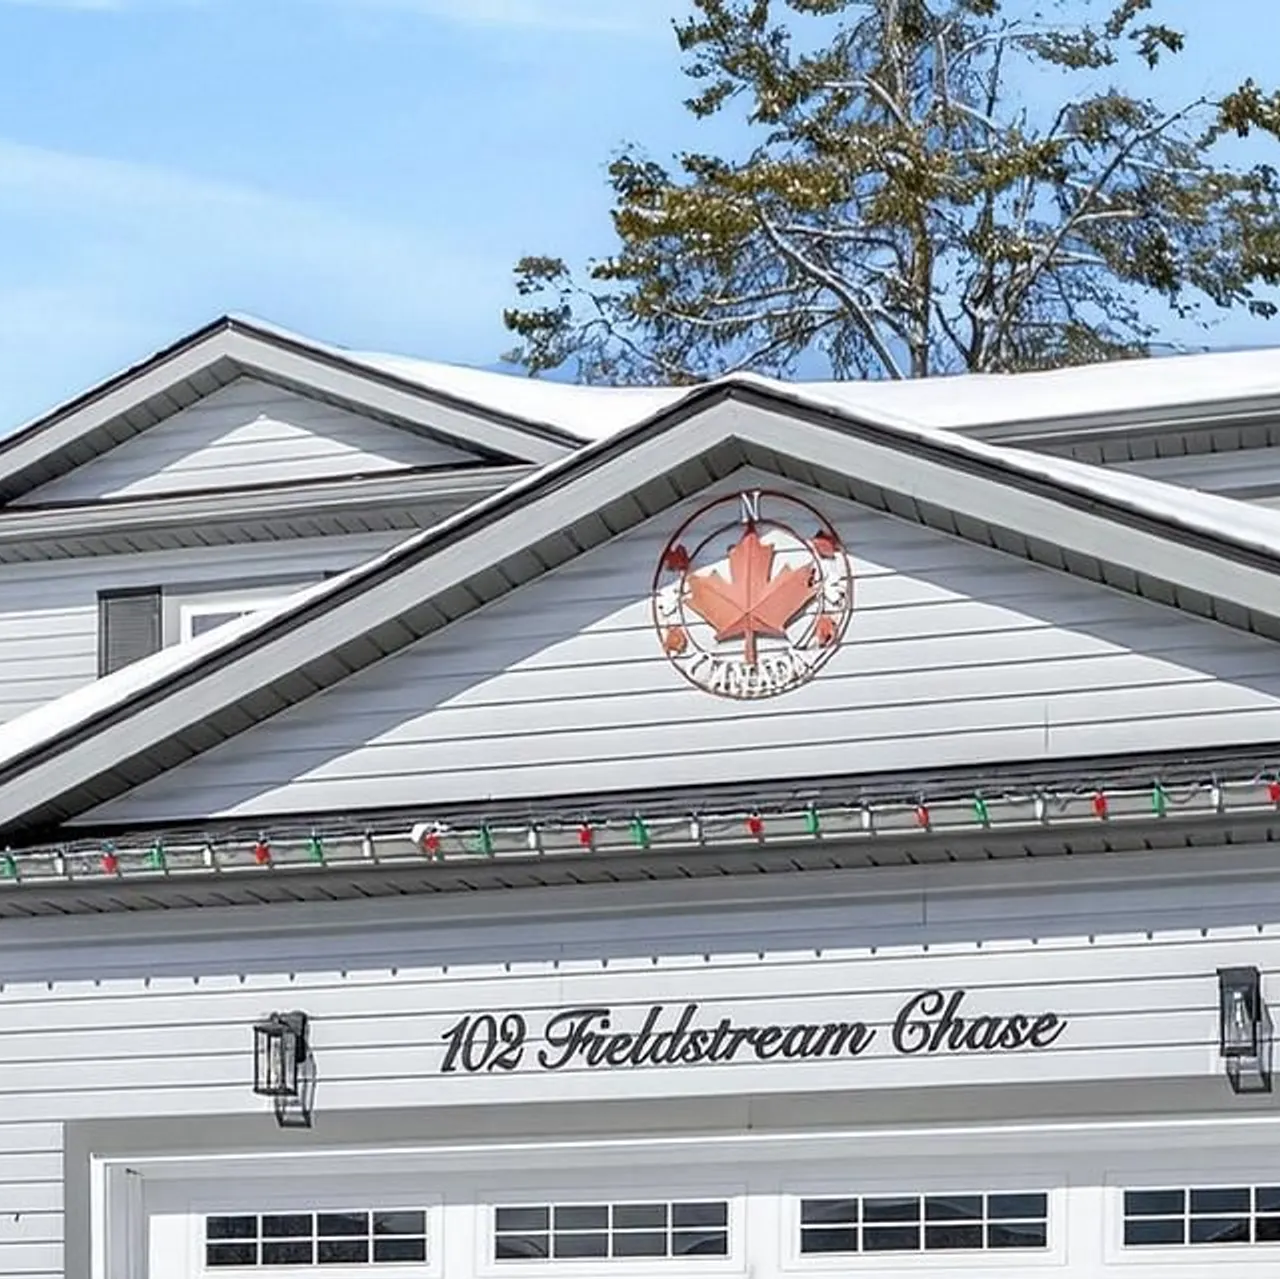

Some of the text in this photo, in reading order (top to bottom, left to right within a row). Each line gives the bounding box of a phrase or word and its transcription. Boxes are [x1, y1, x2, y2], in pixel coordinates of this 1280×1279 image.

[685, 649, 818, 697] CANADA
[441, 989, 1068, 1072] 102 Fieldstream Chase
